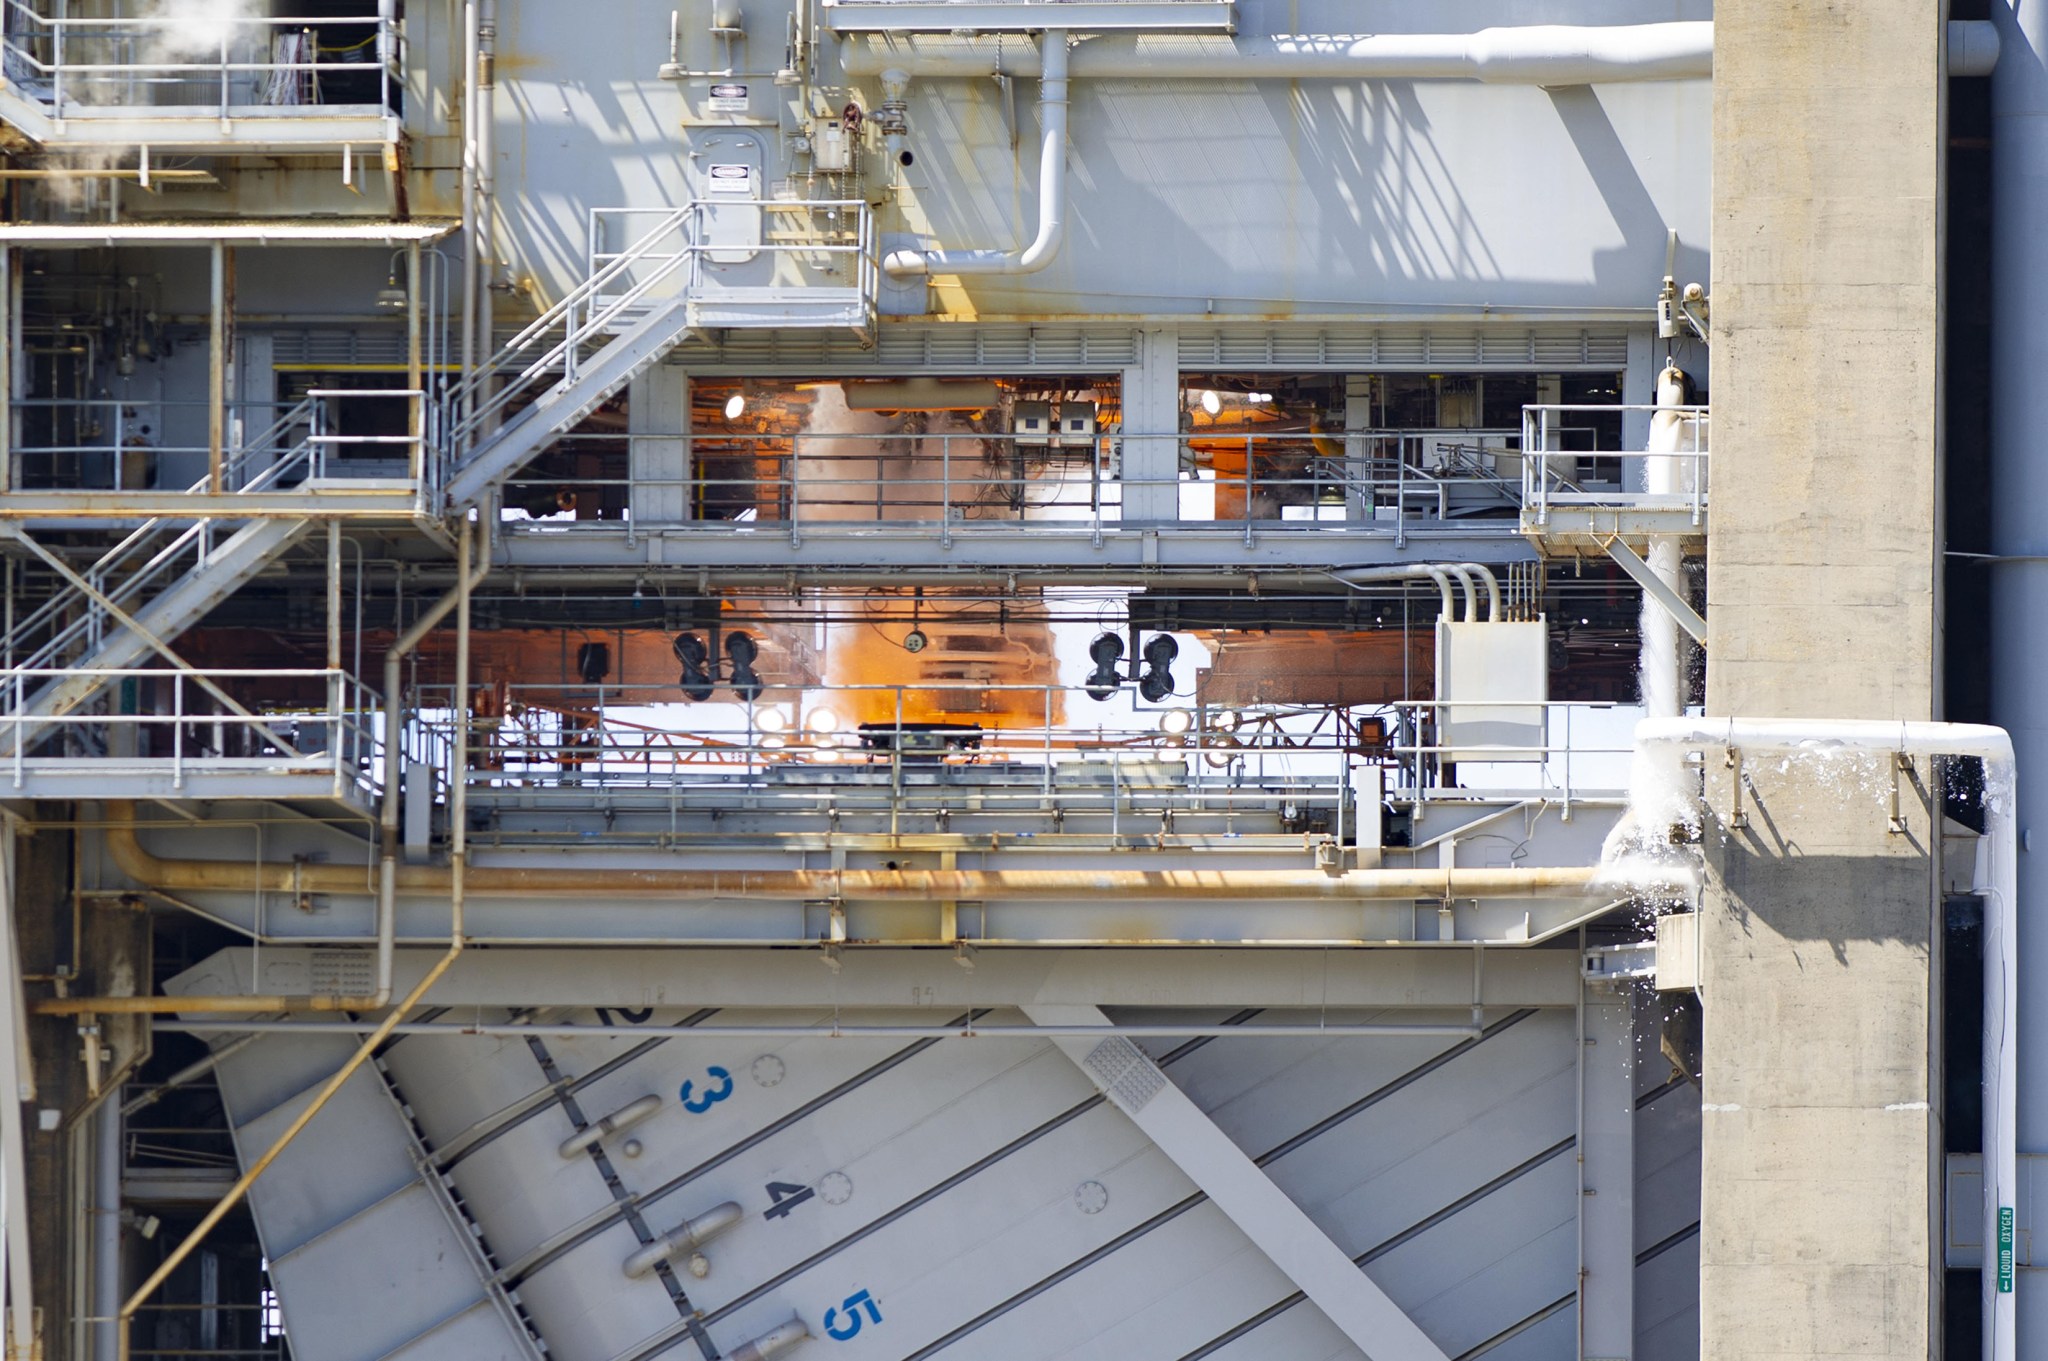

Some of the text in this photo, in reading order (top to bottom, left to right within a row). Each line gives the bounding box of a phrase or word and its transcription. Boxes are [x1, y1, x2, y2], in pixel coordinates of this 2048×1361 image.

[680, 1066, 733, 1114] 3
[763, 1181, 815, 1221] 4
[2001, 1209, 2011, 1279] LIQUID OXYGEN
[824, 1288, 883, 1341] 5
